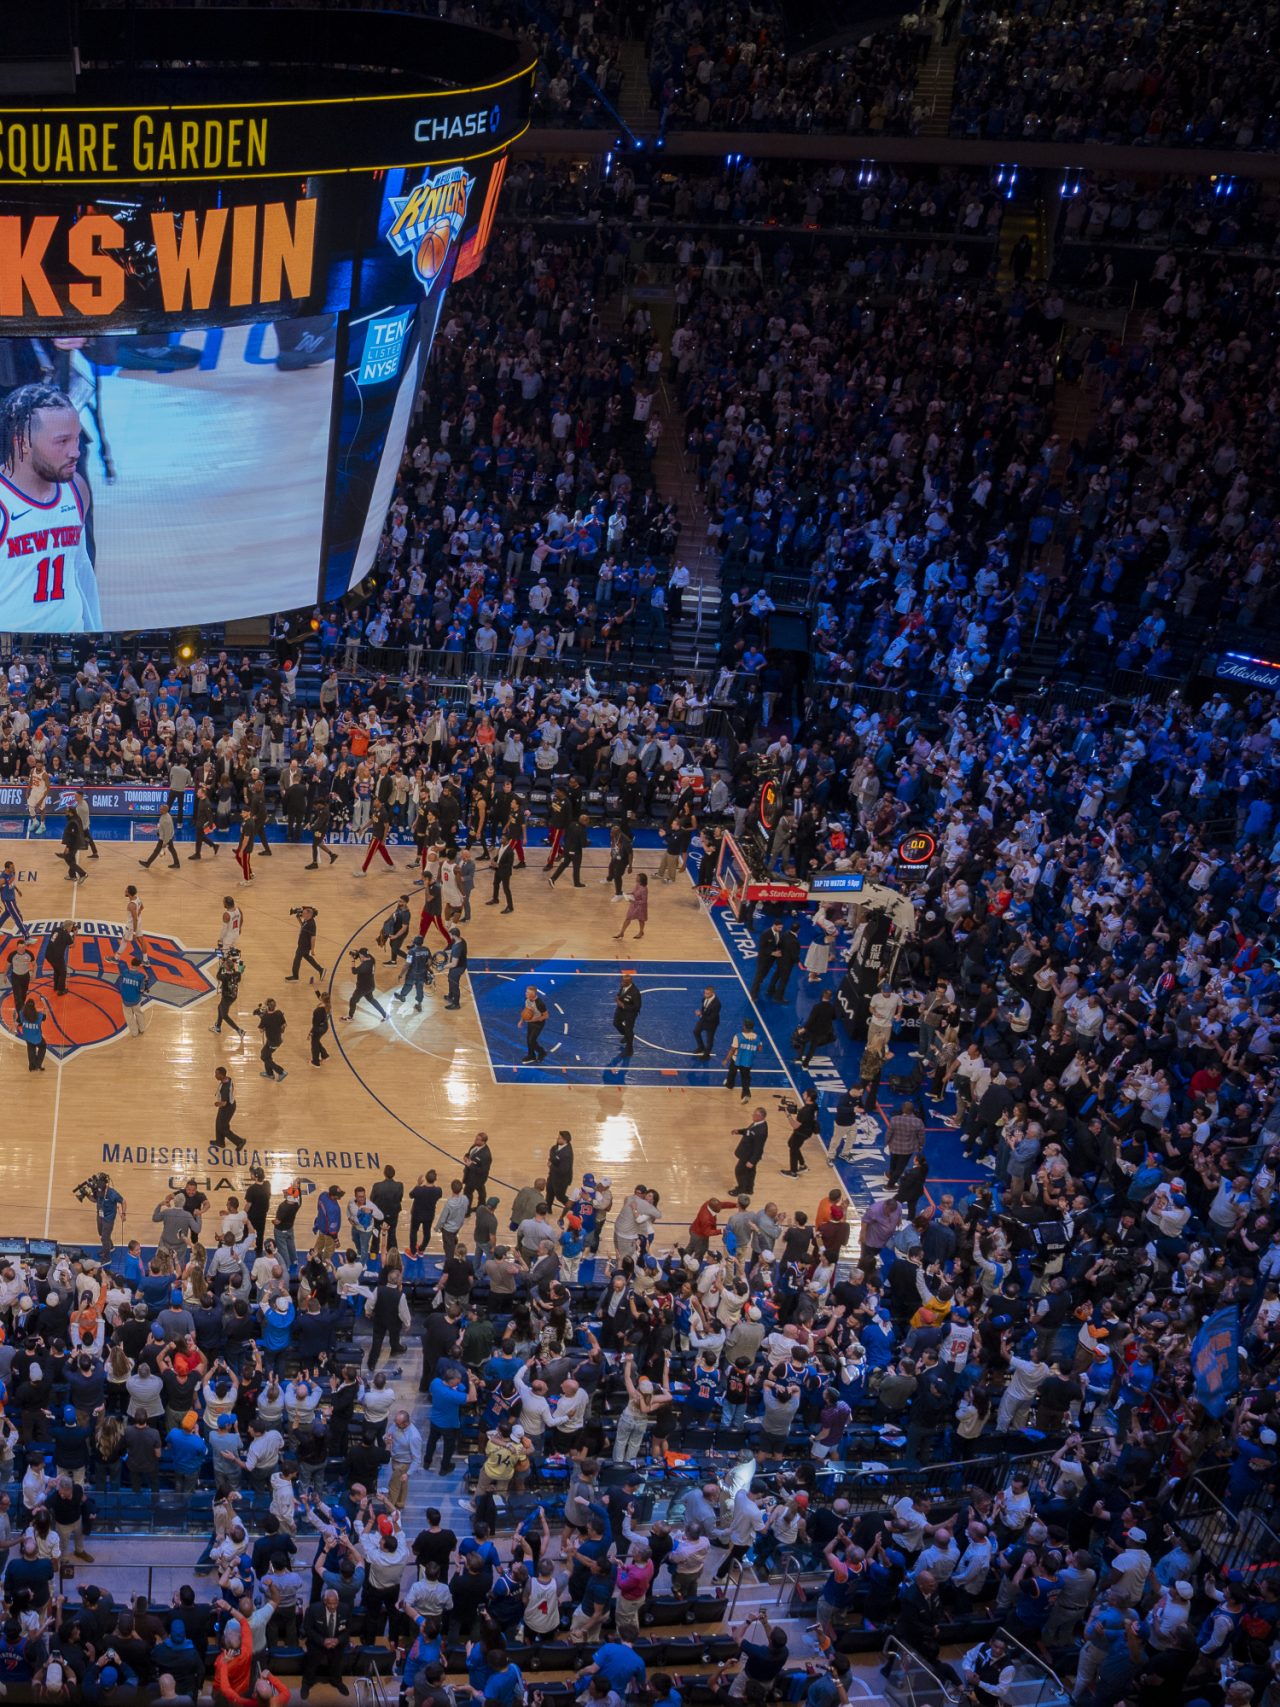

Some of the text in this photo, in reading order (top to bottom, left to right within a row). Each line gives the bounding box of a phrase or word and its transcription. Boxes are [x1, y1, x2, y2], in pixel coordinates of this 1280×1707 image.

[414, 110, 488, 142] CHASE
[133, 115, 268, 171] GARDEN
[391, 175, 468, 236] KNICKS
[151, 198, 317, 312] WIN
[373, 318, 405, 344] TEN
[367, 345, 400, 360] LISTED
[363, 359, 399, 380] NYSE
[7, 525, 83, 558] NEW YORK
[33, 554, 65, 603] 11
[1216, 661, 1279, 685] Michelob
[92, 794, 119, 808] GAME 2
[124, 790, 162, 802] TOMORROW
[330, 831, 399, 845] PLAYOFS
[911, 840, 925, 849] 0.0
[720, 910, 759, 960] ULTRA
[102, 1143, 380, 1169] MADISON SQUAR GARDEN
[497, 1453, 511, 1468] 14
